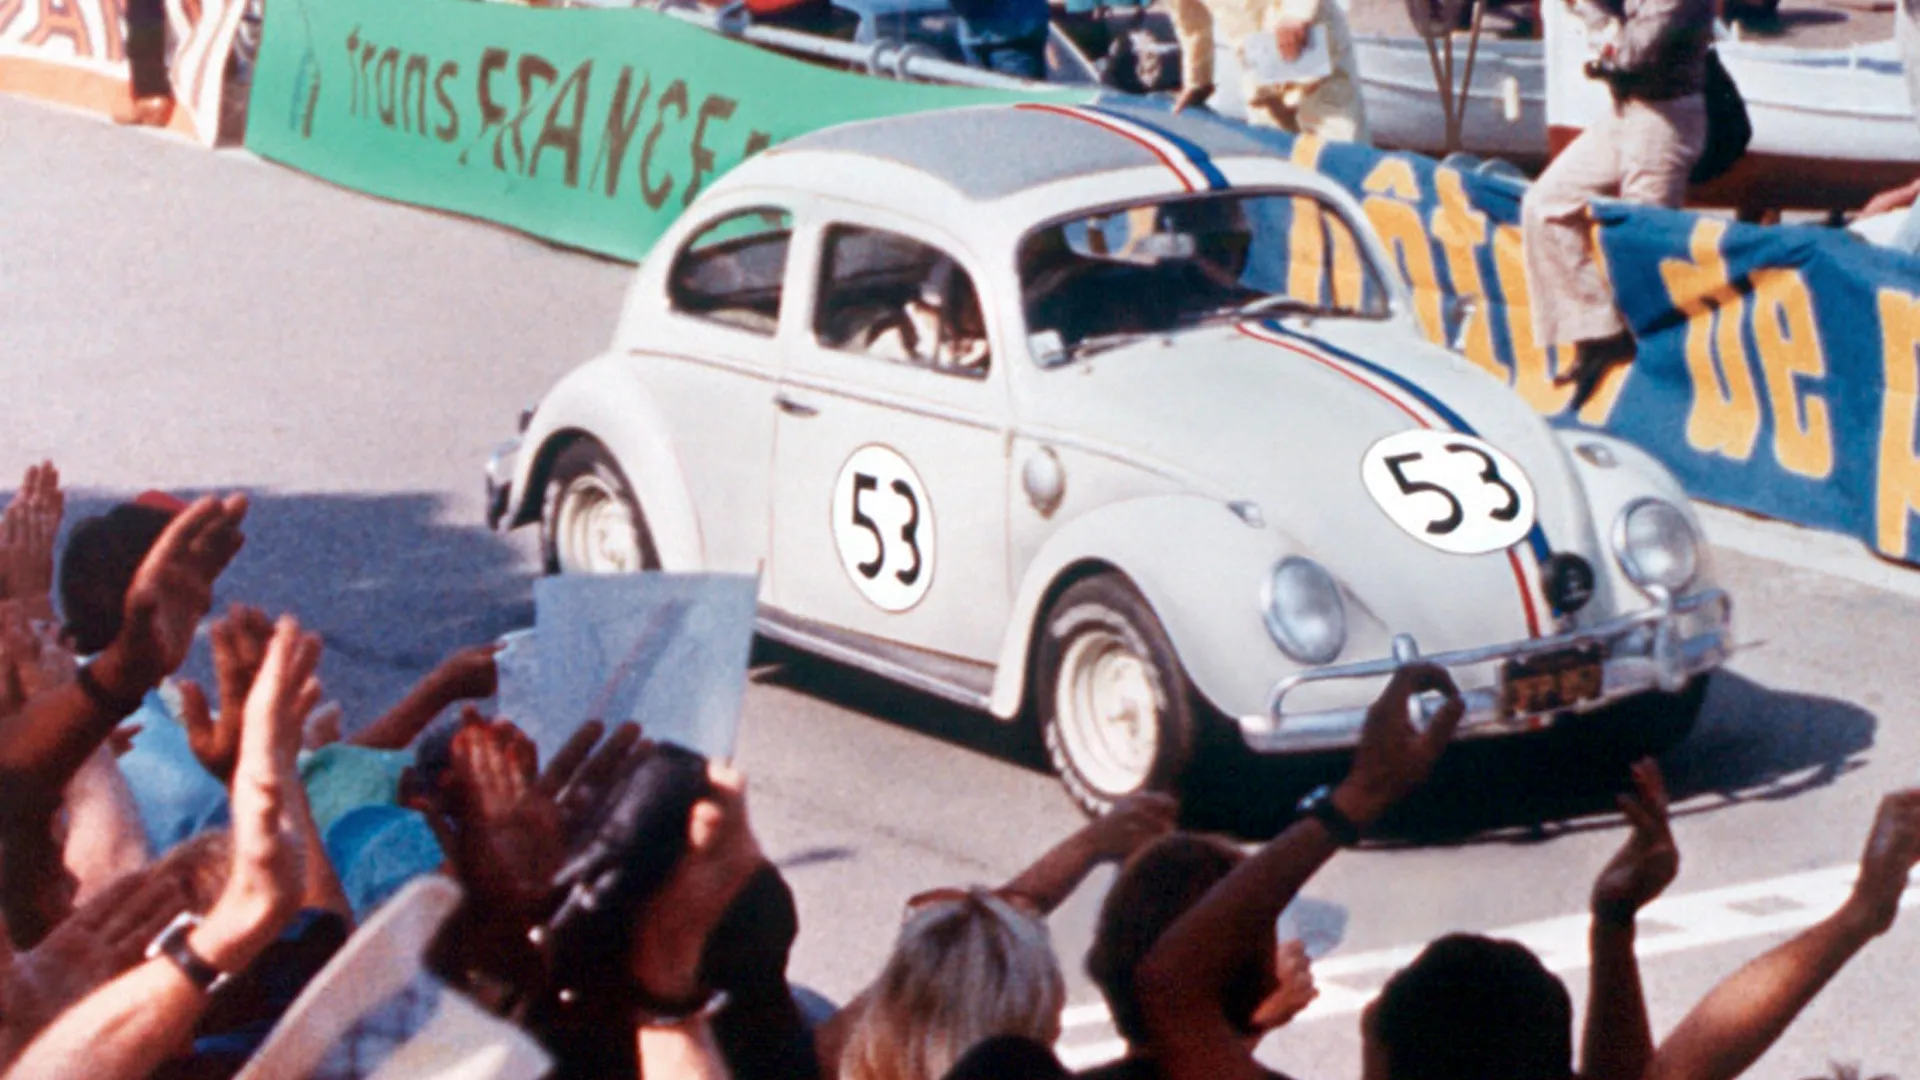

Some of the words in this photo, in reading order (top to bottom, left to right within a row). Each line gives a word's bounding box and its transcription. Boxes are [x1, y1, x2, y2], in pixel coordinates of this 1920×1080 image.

[346, 22, 459, 143] trans
[1658, 217, 1833, 481] de
[852, 471, 921, 586] 53
[1383, 443, 1520, 535] 53
